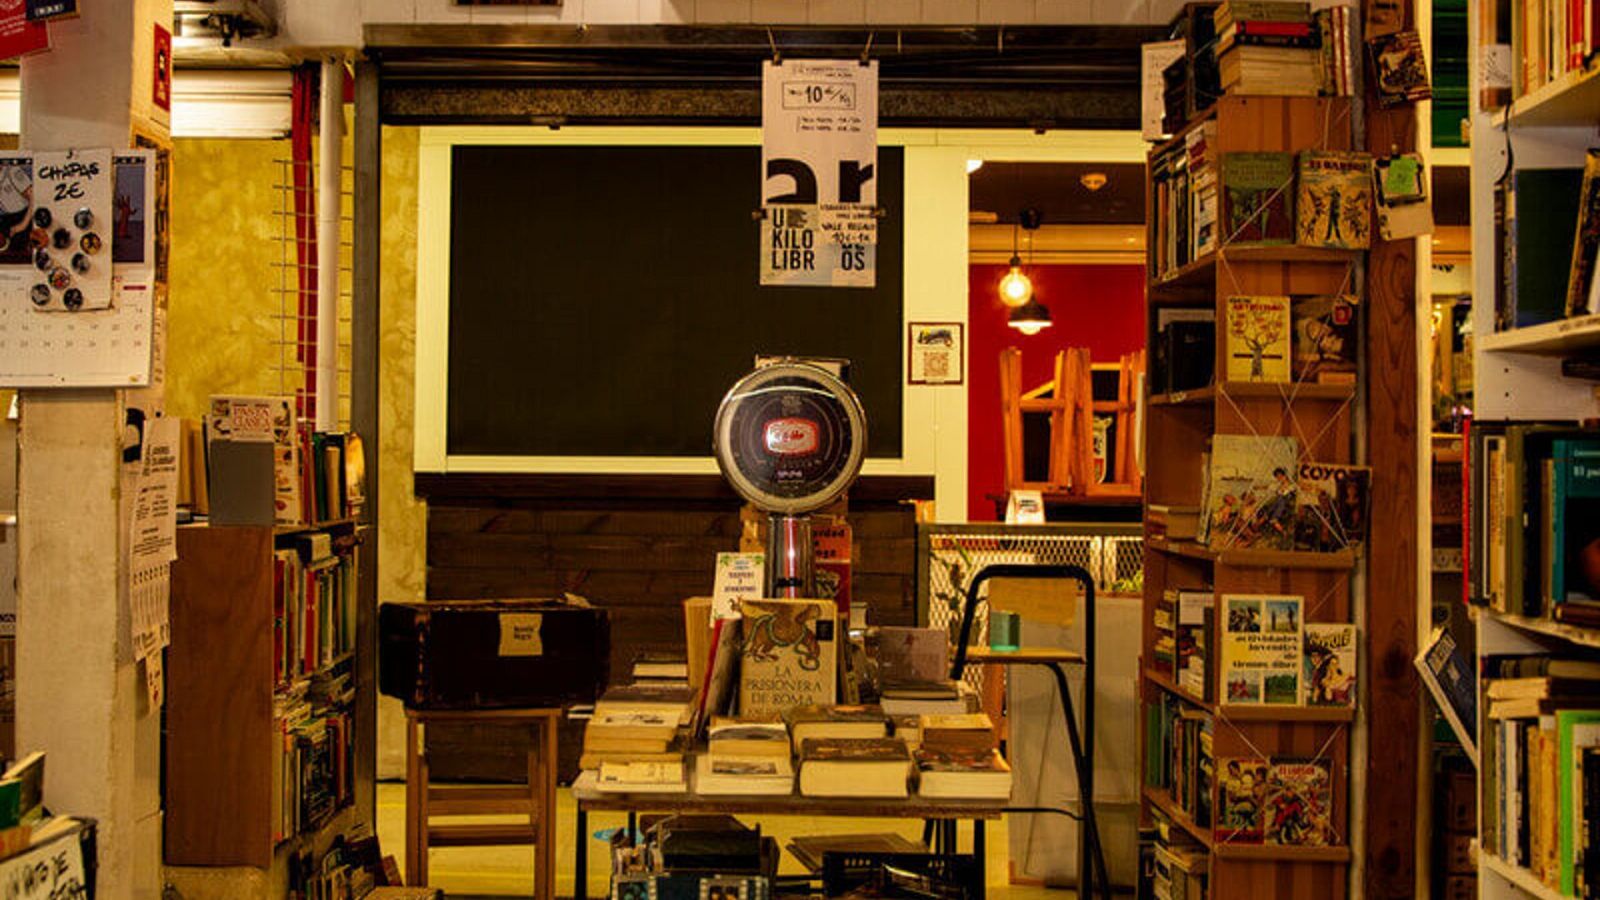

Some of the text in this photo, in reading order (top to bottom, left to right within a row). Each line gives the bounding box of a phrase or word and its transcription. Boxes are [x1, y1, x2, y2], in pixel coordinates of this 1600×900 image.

[806, 85, 823, 103] 10
[38, 162, 100, 181] CHAPAS
[54, 182, 85, 202] 2€
[772, 229, 814, 249] KILO
[771, 250, 865, 271] LIBR OS
[233, 407, 269, 418] PASTA
[775, 665, 792, 677] LA
[745, 679, 822, 692] PRISIONERA
[751, 692, 815, 704] DE ROMA
